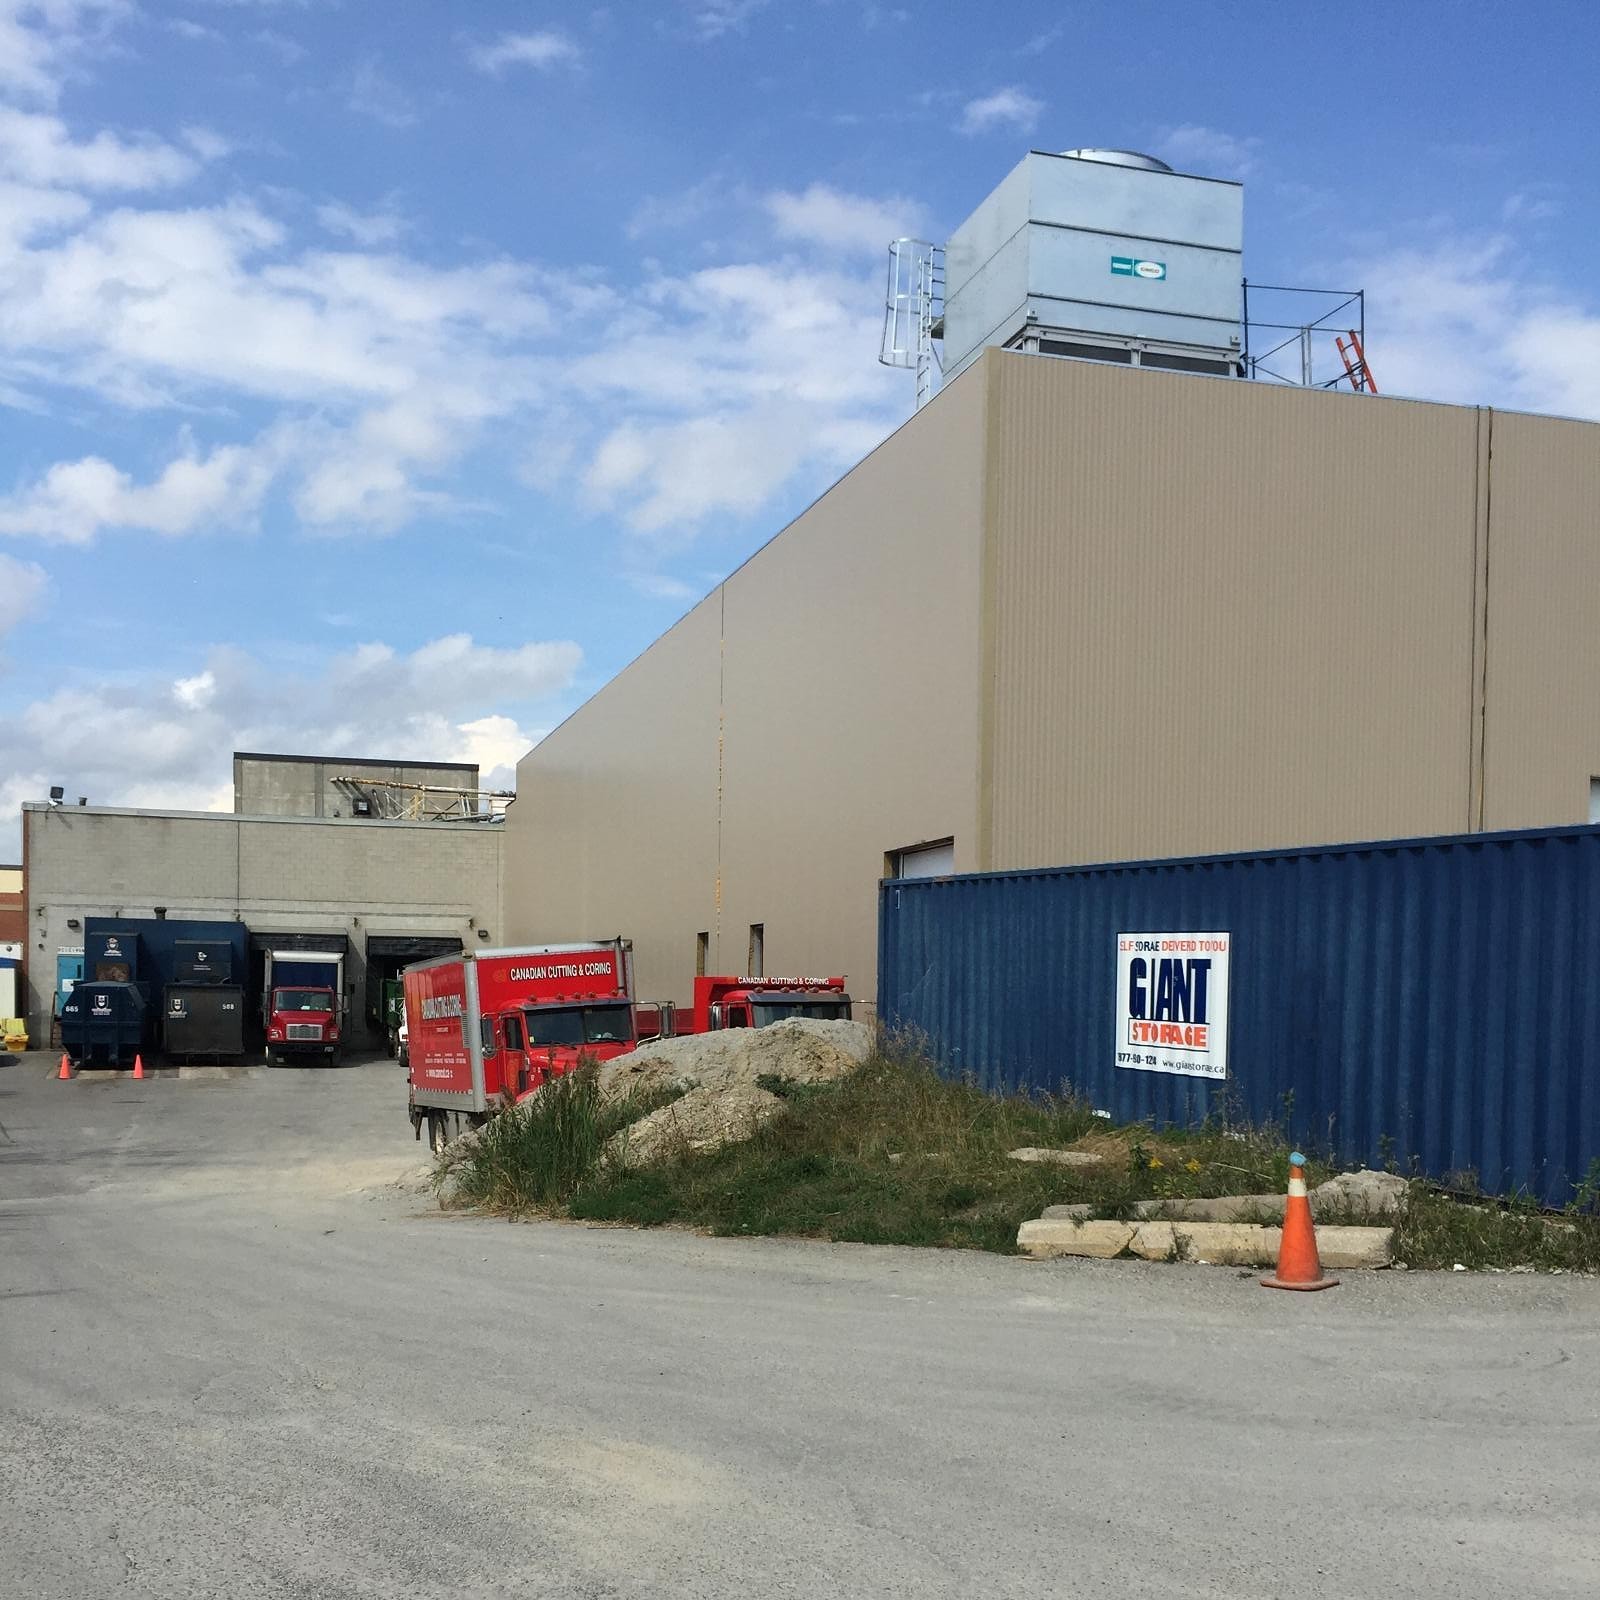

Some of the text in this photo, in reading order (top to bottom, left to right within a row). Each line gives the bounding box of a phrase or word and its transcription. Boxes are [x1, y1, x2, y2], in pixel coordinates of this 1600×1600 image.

[510, 962, 611, 981] CANADIAN CUTTING & CORING
[737, 976, 829, 985] CANADIAN CUTTING & CORING
[1129, 957, 1212, 1024] GIANT
[1132, 1022, 1207, 1047] STORAGE
